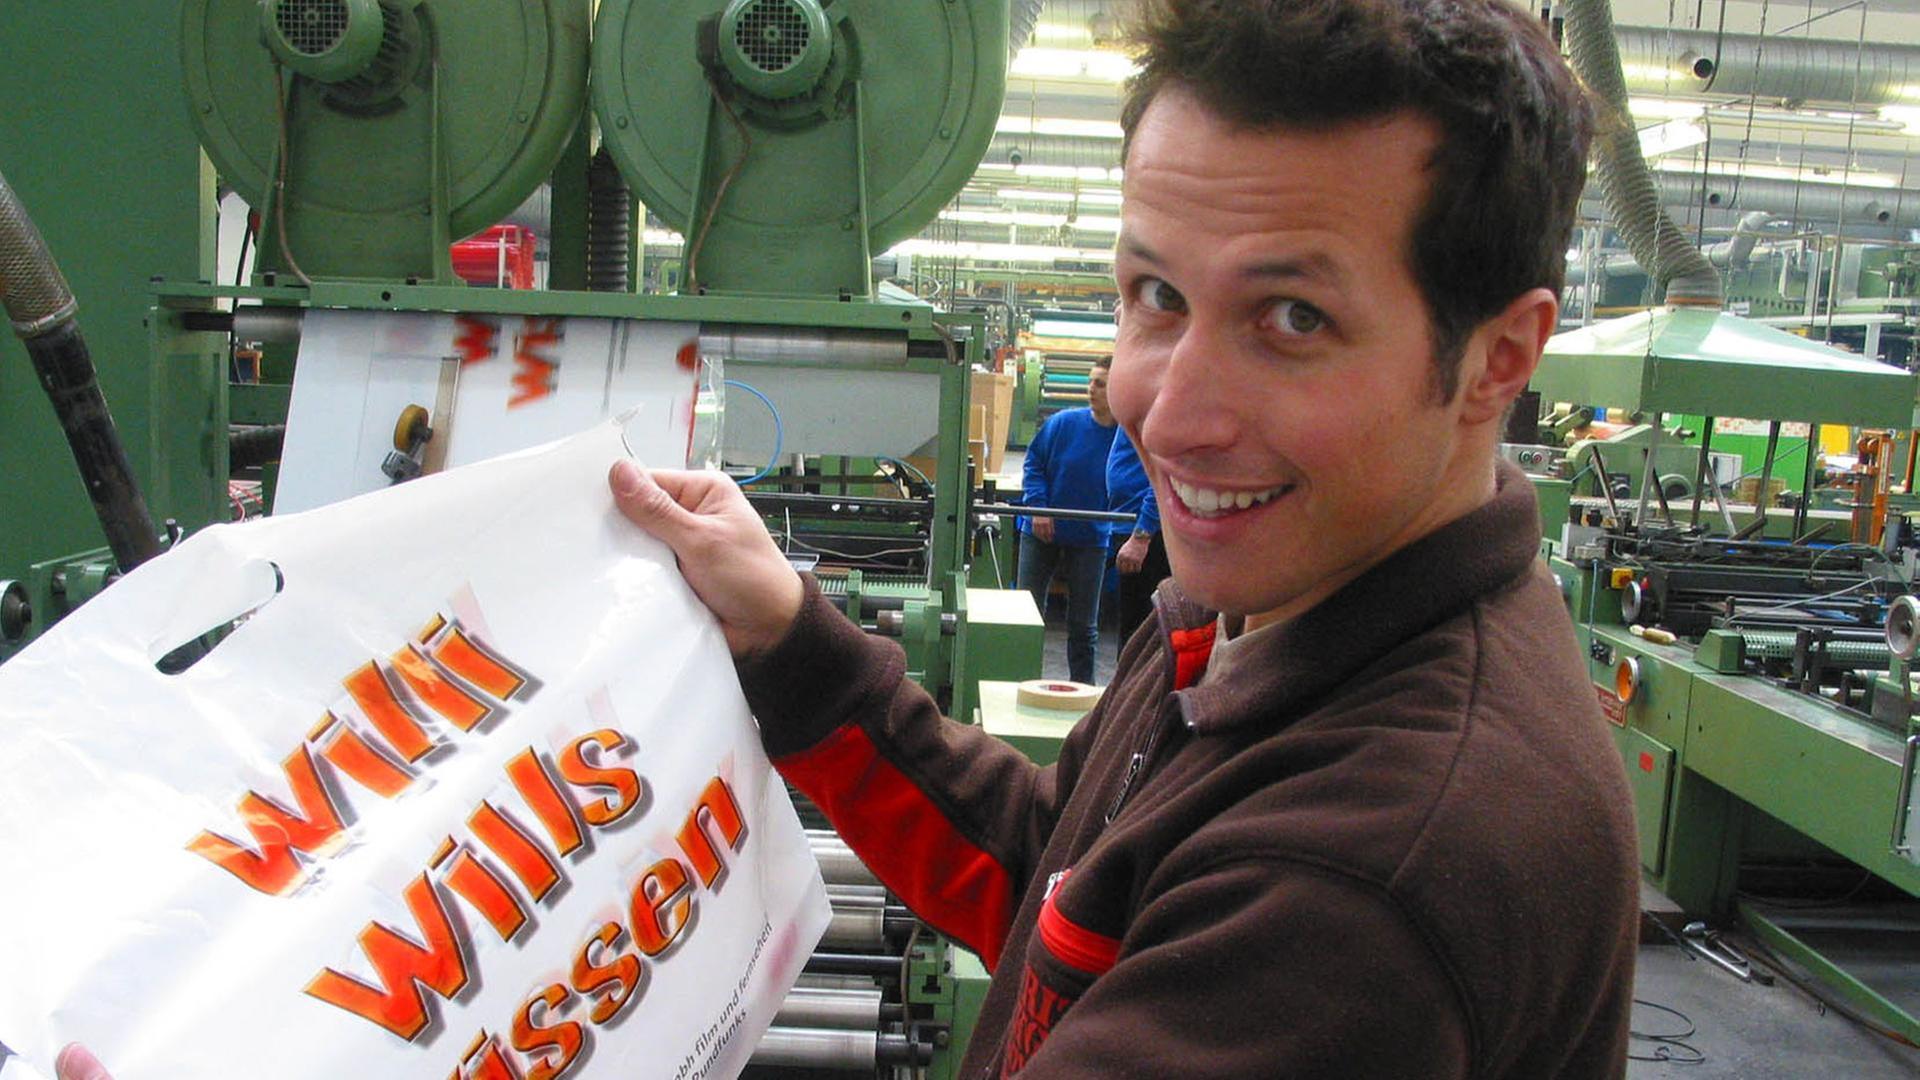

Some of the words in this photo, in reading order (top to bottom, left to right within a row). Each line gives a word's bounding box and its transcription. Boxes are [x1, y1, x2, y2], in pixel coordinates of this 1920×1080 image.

[447, 775, 749, 1080] issen
[695, 1023, 719, 1057] film
[719, 991, 740, 1024] und
[738, 919, 773, 996] fernsehen
